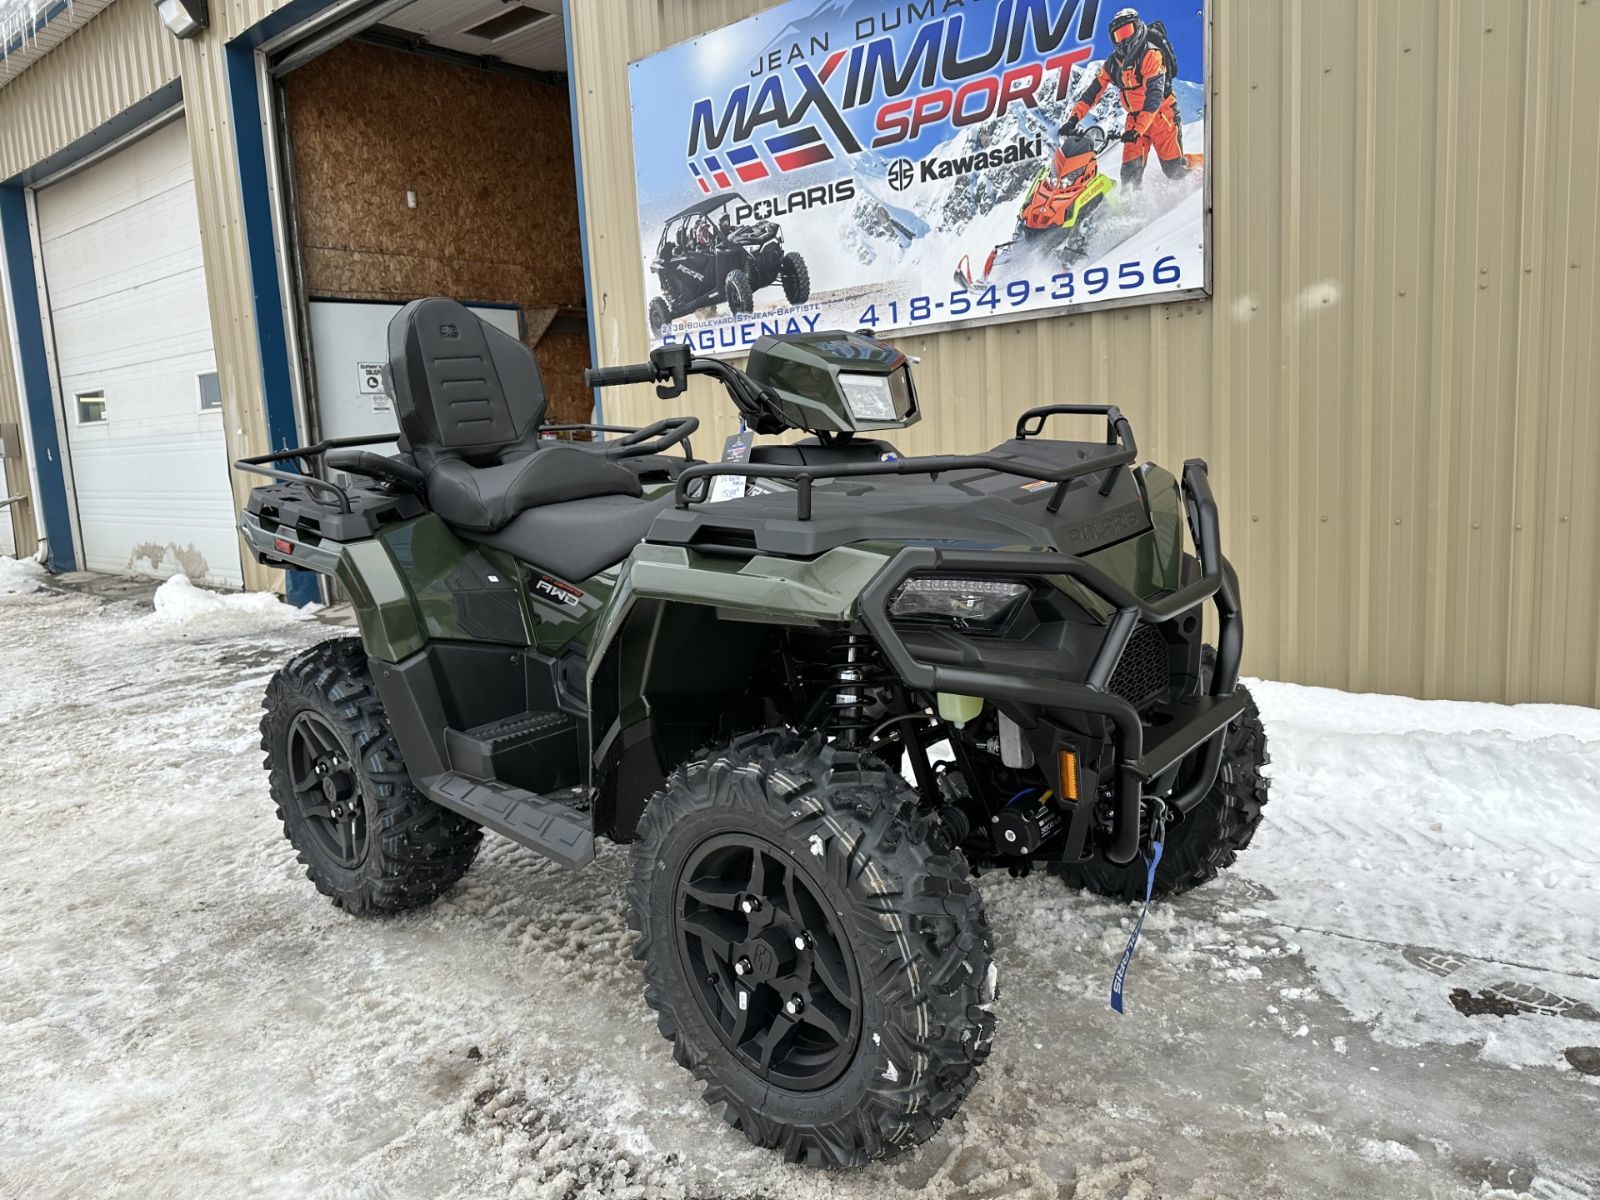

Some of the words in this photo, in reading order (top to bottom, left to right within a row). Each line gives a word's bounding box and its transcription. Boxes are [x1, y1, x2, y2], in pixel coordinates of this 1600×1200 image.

[750, 31, 829, 78] JEAN
[856, 0, 982, 40] DUMA
[688, 0, 1100, 156] MAXIMUM
[872, 47, 1092, 149] SPORT
[920, 133, 1042, 183] Kawasaki
[736, 178, 855, 225] POLARIS
[859, 255, 1181, 327] 418-549-3956
[662, 323, 684, 334] 2138
[536, 580, 579, 607] AWD
